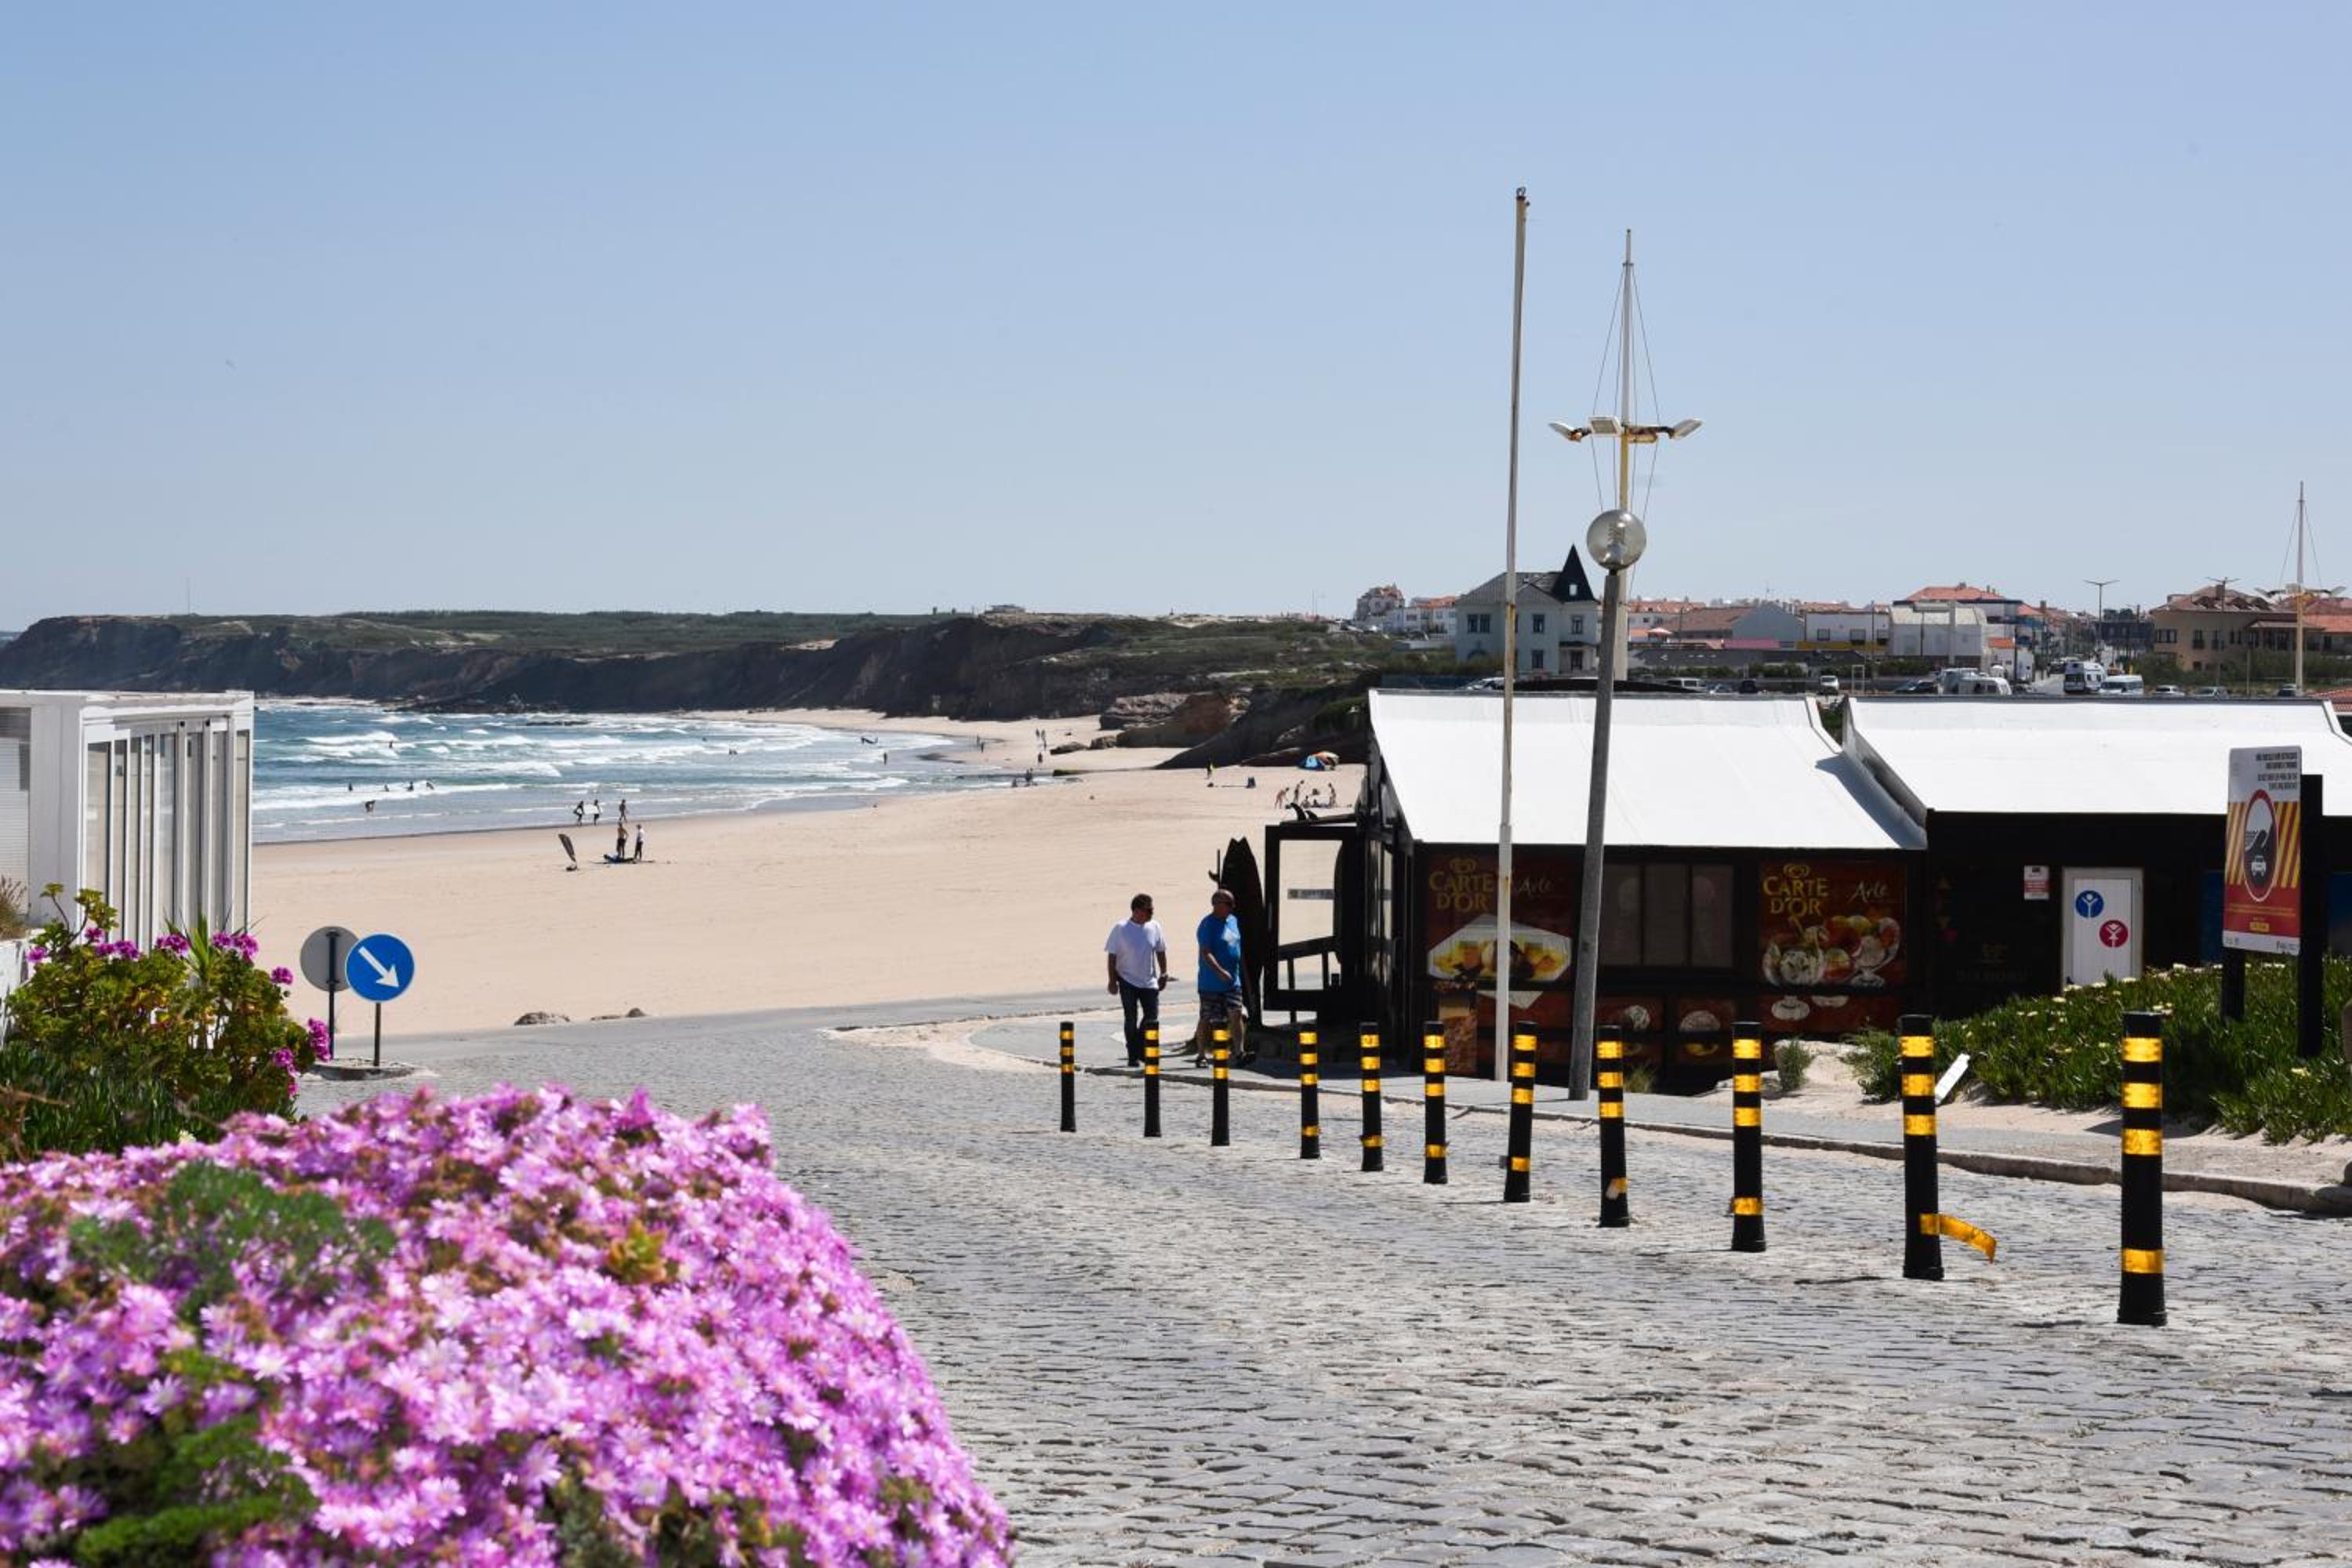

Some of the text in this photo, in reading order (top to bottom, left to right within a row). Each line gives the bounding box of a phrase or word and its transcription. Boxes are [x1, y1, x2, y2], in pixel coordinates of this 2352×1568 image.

[1430, 871, 1494, 891] CARTE
[1762, 876, 1828, 897] CARTE
[1437, 891, 1491, 911] D'OR
[1770, 897, 1822, 916] D'OR
